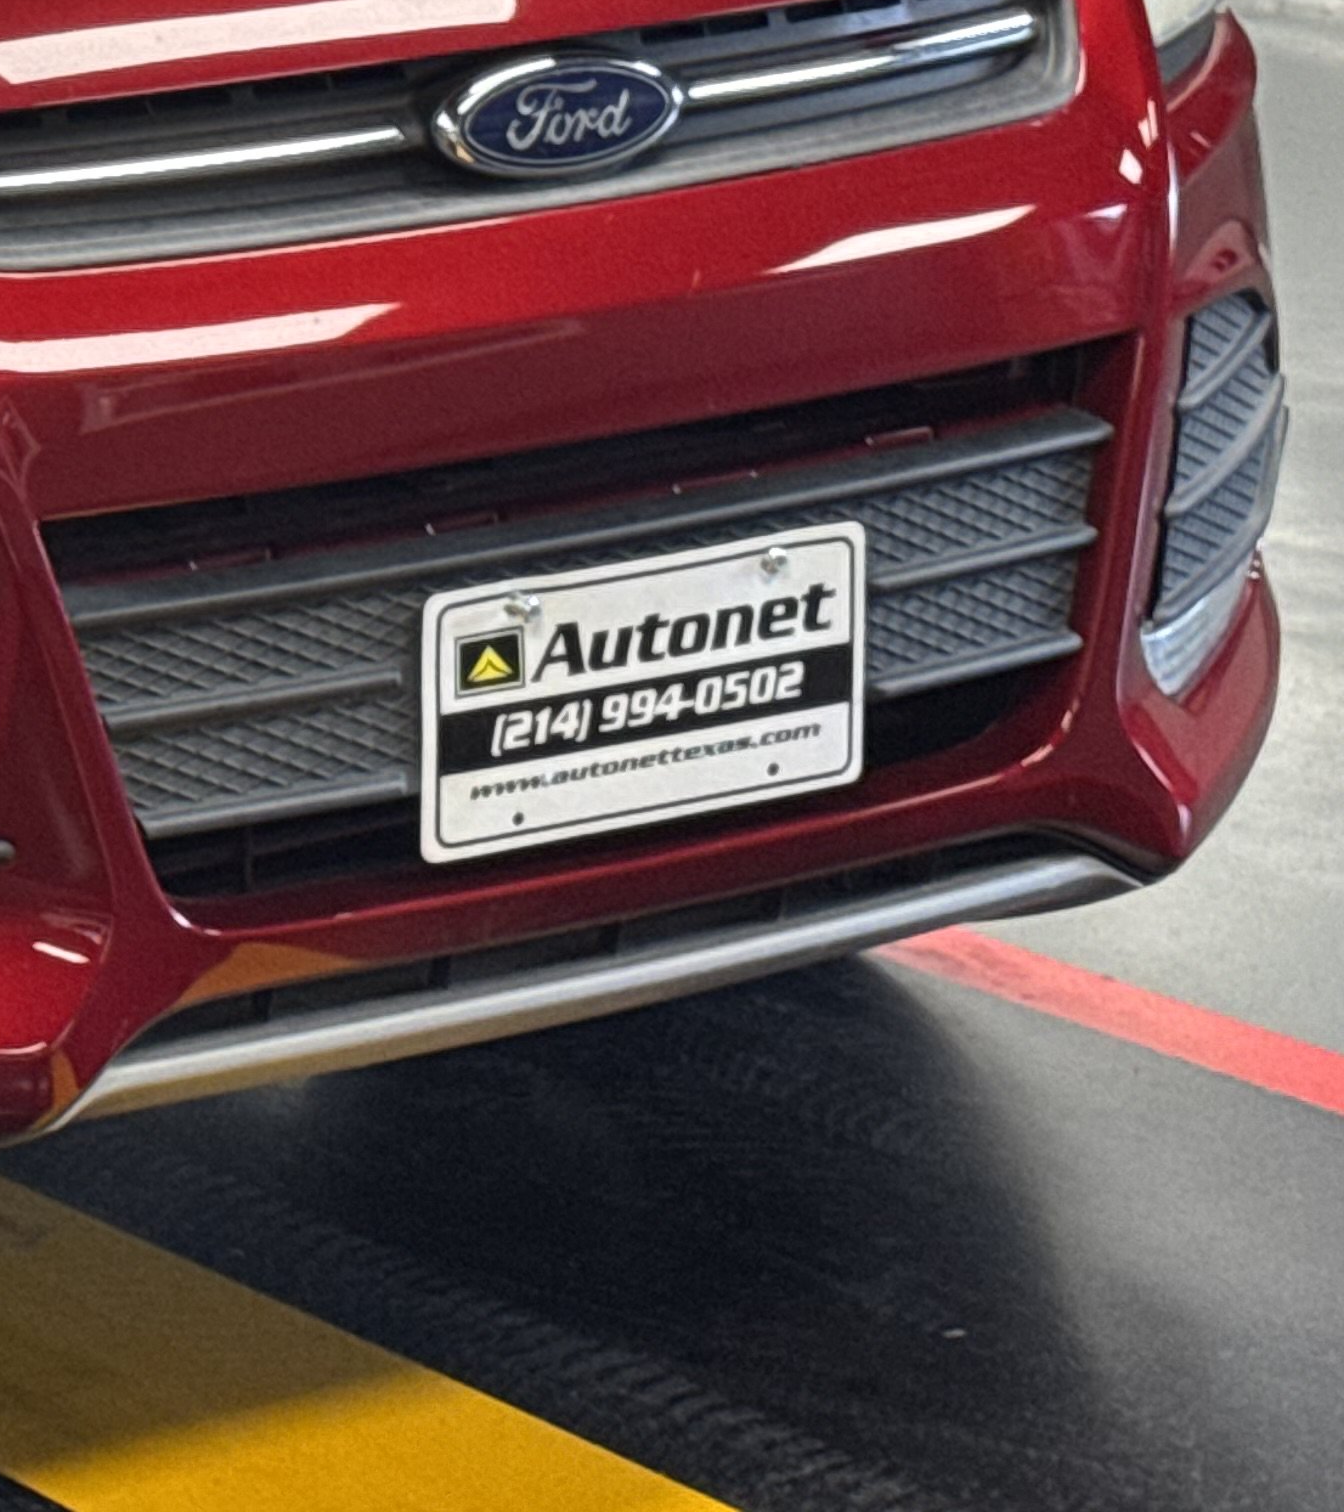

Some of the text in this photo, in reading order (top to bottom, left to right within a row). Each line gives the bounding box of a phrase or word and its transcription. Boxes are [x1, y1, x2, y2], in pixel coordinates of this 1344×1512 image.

[505, 77, 632, 152] Ford
[530, 582, 836, 683] Autonet
[490, 660, 805, 757] (214) 994-0502
[469, 722, 822, 801] www.autonettexas.com
